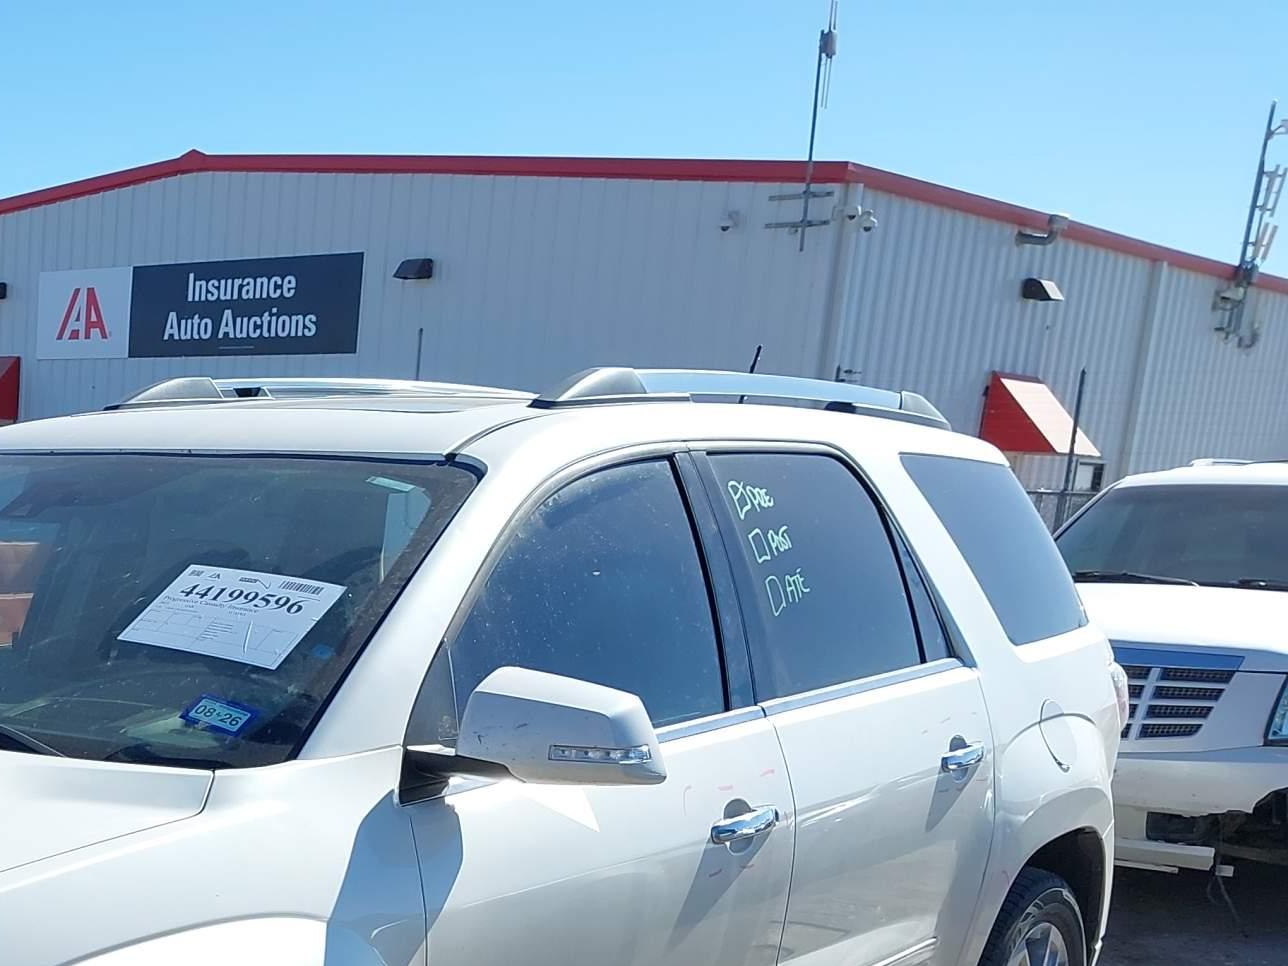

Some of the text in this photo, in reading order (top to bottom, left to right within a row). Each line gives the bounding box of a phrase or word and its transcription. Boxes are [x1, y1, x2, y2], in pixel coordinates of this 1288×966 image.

[187, 272, 297, 302] Insurance
[163, 307, 318, 341] Auto Auctions
[179, 583, 305, 615] 44199596
